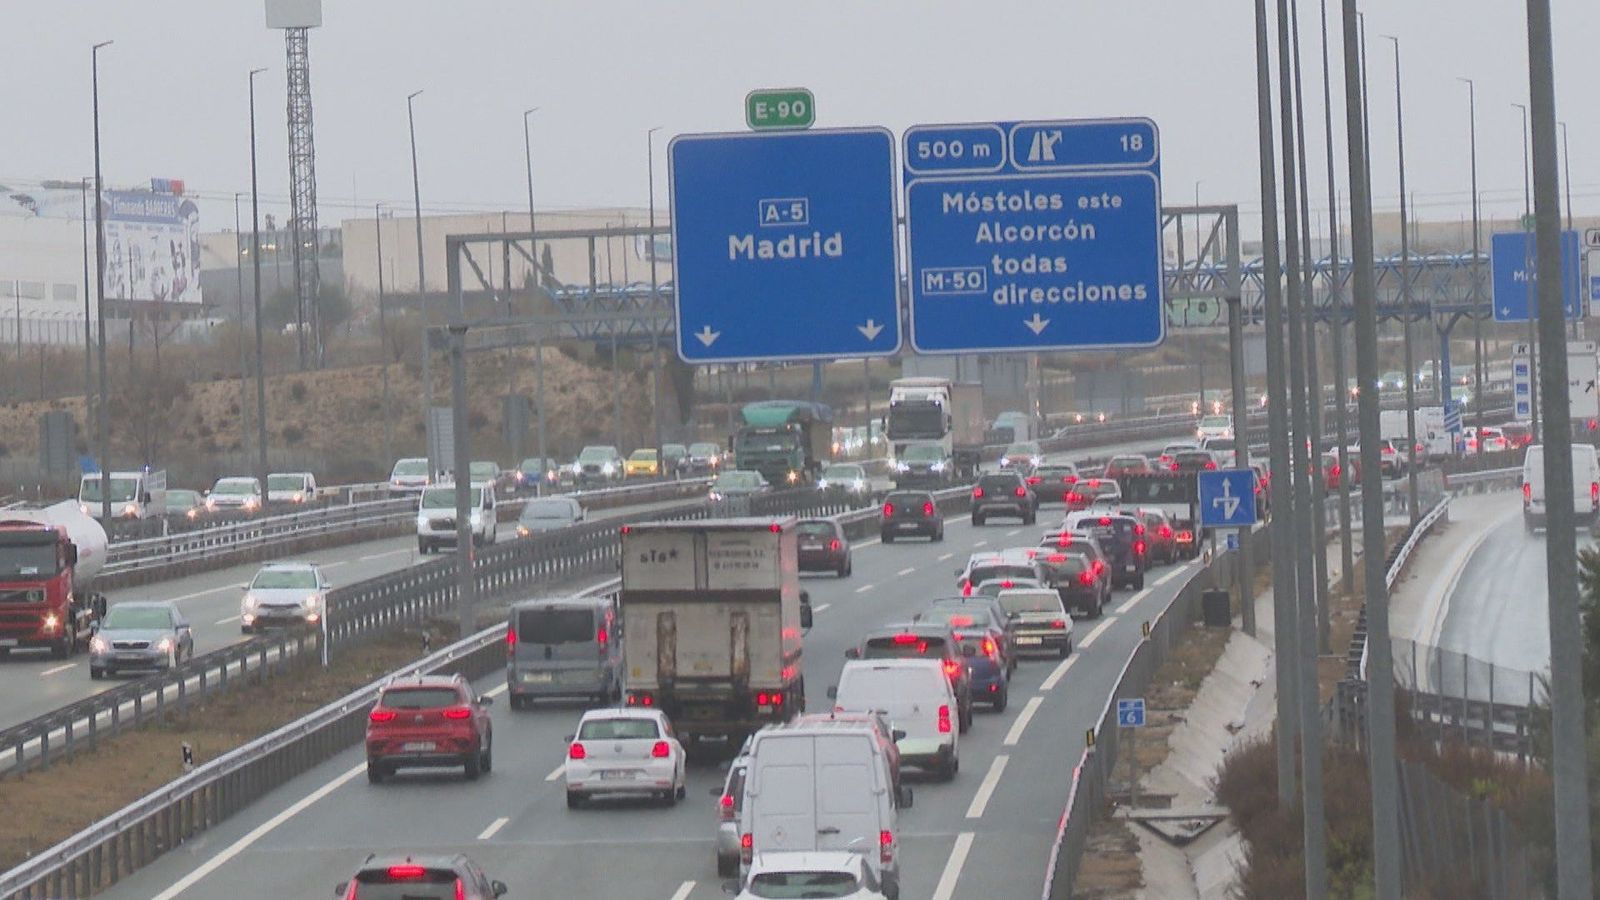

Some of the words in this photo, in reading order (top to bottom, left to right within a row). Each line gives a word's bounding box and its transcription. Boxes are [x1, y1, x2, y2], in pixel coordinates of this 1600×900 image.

[756, 101, 805, 119] E-90
[919, 141, 963, 159] 500
[973, 144, 990, 157] m
[1121, 134, 1142, 151] 18
[764, 201, 803, 221] A-5
[943, 190, 1062, 213] Móstoles
[1078, 193, 1122, 209] este
[976, 220, 1095, 243] Alcorcón
[729, 232, 842, 260] Madrid
[992, 255, 1067, 274] todas
[925, 270, 980, 289] M-50
[993, 281, 1146, 304] direcciones
[1126, 711, 1136, 723] 6
